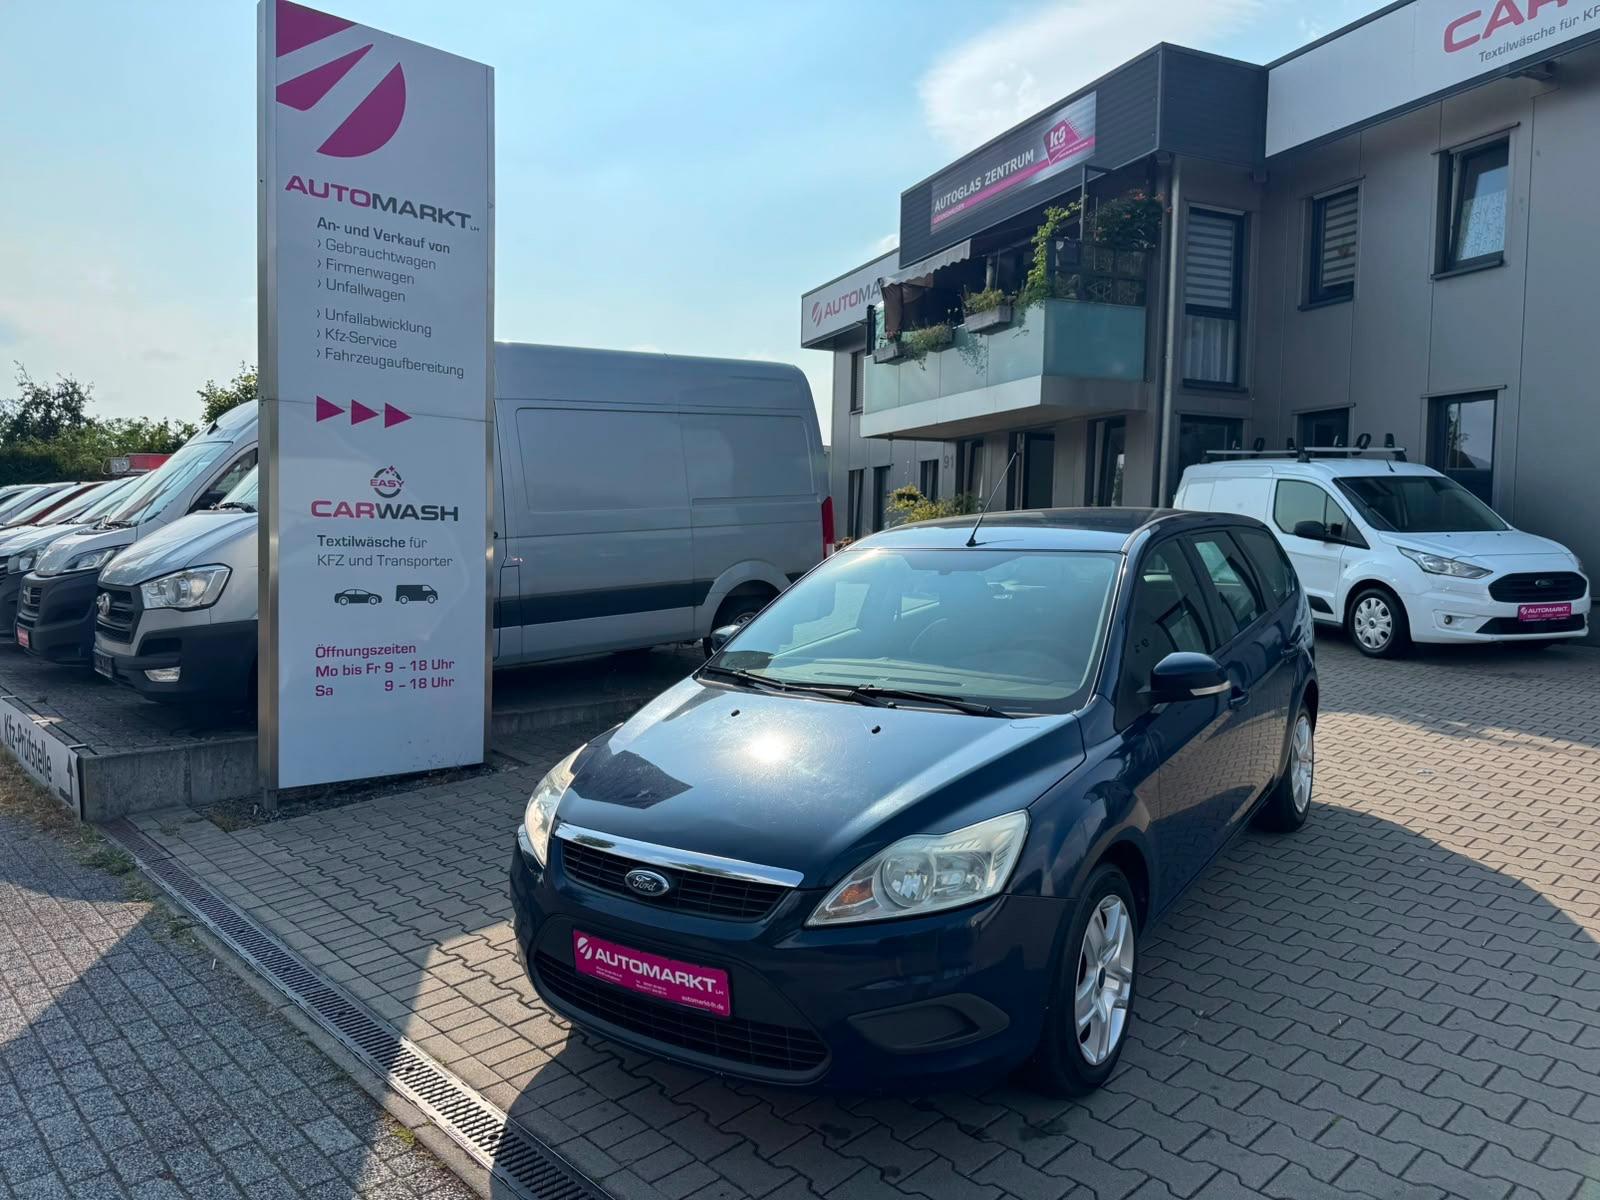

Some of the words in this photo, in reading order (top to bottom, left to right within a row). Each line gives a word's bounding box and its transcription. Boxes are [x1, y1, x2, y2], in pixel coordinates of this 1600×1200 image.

[1479, 25, 1556, 63] Textilwäsche
[1560, 16, 1580, 31] für
[934, 177, 982, 213] AUTOGLAS
[984, 149, 1034, 187] ZENTRUM
[285, 175, 471, 229] AUTOMARKT
[316, 216, 341, 232] An-
[344, 224, 370, 238] und
[373, 227, 426, 249] Verkauf
[428, 242, 451, 254] von
[325, 238, 437, 270] Gebrauchtwagen
[326, 258, 415, 285] Firmenwagen
[326, 278, 406, 302] Unfallwagen
[823, 280, 882, 320] AUTOMA
[325, 307, 433, 338] Unfallabwicklung
[325, 327, 398, 349] Kfz-Service
[325, 347, 465, 380] Fahrzeugaufbereitung
[370, 478, 405, 489] EASY
[311, 500, 459, 522] CARWASH
[317, 534, 406, 549] Textilwäsche
[409, 536, 428, 549] für
[317, 554, 345, 567] KFZ
[348, 554, 373, 567] und
[376, 554, 454, 570] Transporter
[315, 643, 417, 660] Öffnungszeiten
[315, 665, 338, 678] Mo
[342, 662, 363, 676] bis
[366, 662, 381, 676] Fr
[384, 661, 395, 674] 9
[410, 660, 428, 672] 18
[431, 658, 455, 671] Uhr
[315, 685, 334, 698] Sa
[384, 680, 395, 692] 9
[410, 678, 428, 690] 18
[431, 676, 455, 689] Uhr
[4, 712, 53, 783] Kfz-Prüfstelle
[633, 875, 657, 891] Ford
[595, 948, 717, 993] AUTOMARKT
